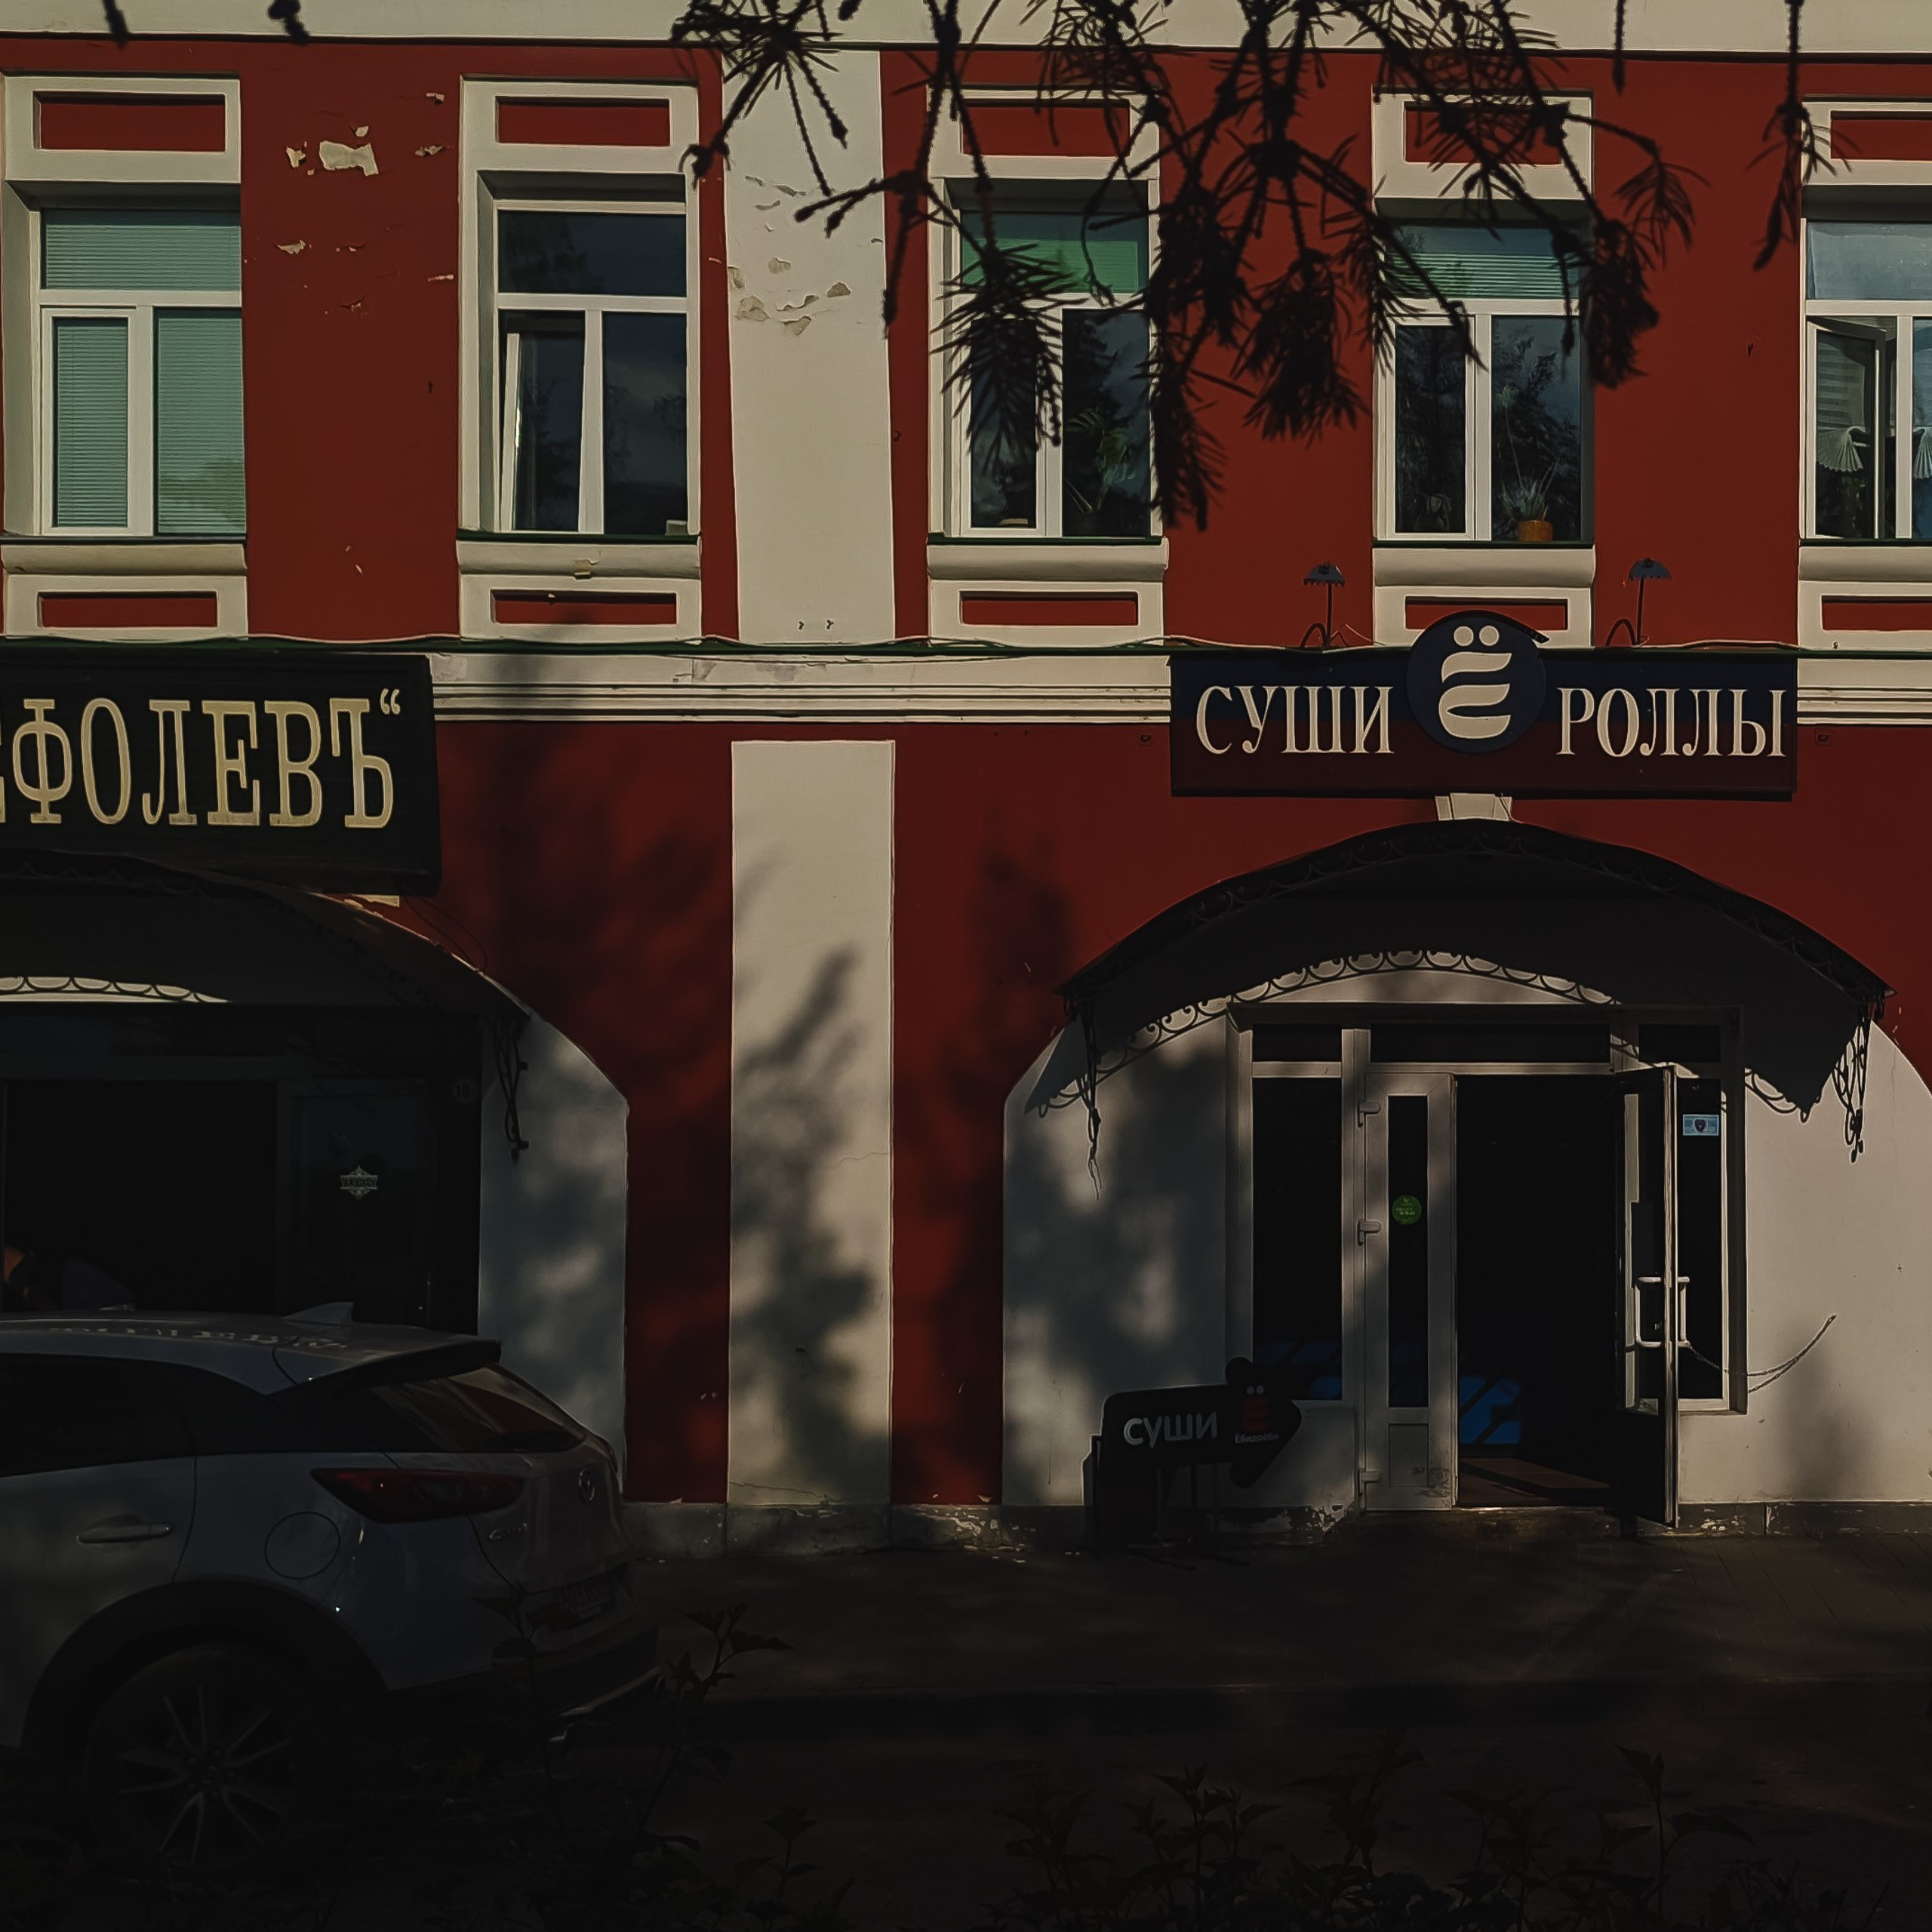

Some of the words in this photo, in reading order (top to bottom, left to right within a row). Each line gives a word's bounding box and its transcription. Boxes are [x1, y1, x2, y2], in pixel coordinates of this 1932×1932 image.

[0, 688, 402, 828] ФОЛЕВЪ“
[1195, 685, 1395, 755] СУШИ
[1556, 686, 1786, 758] РОЛЛЫ
